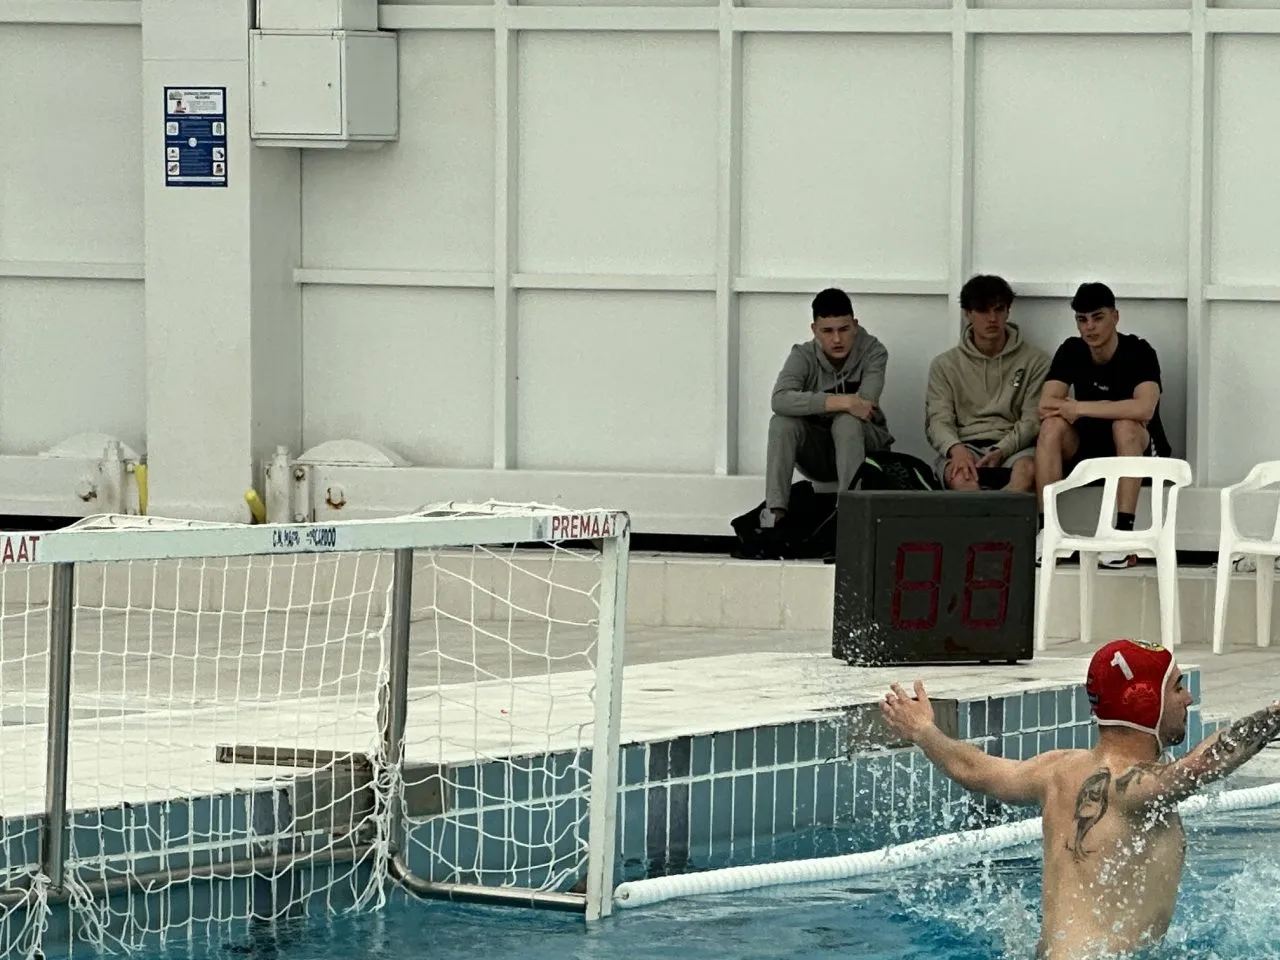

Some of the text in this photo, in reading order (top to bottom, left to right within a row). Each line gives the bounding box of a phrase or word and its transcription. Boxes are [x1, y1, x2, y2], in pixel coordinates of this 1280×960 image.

[552, 514, 617, 539] PREMAAT
[2, 535, 40, 563] AAT
[1110, 650, 1134, 680] 1
